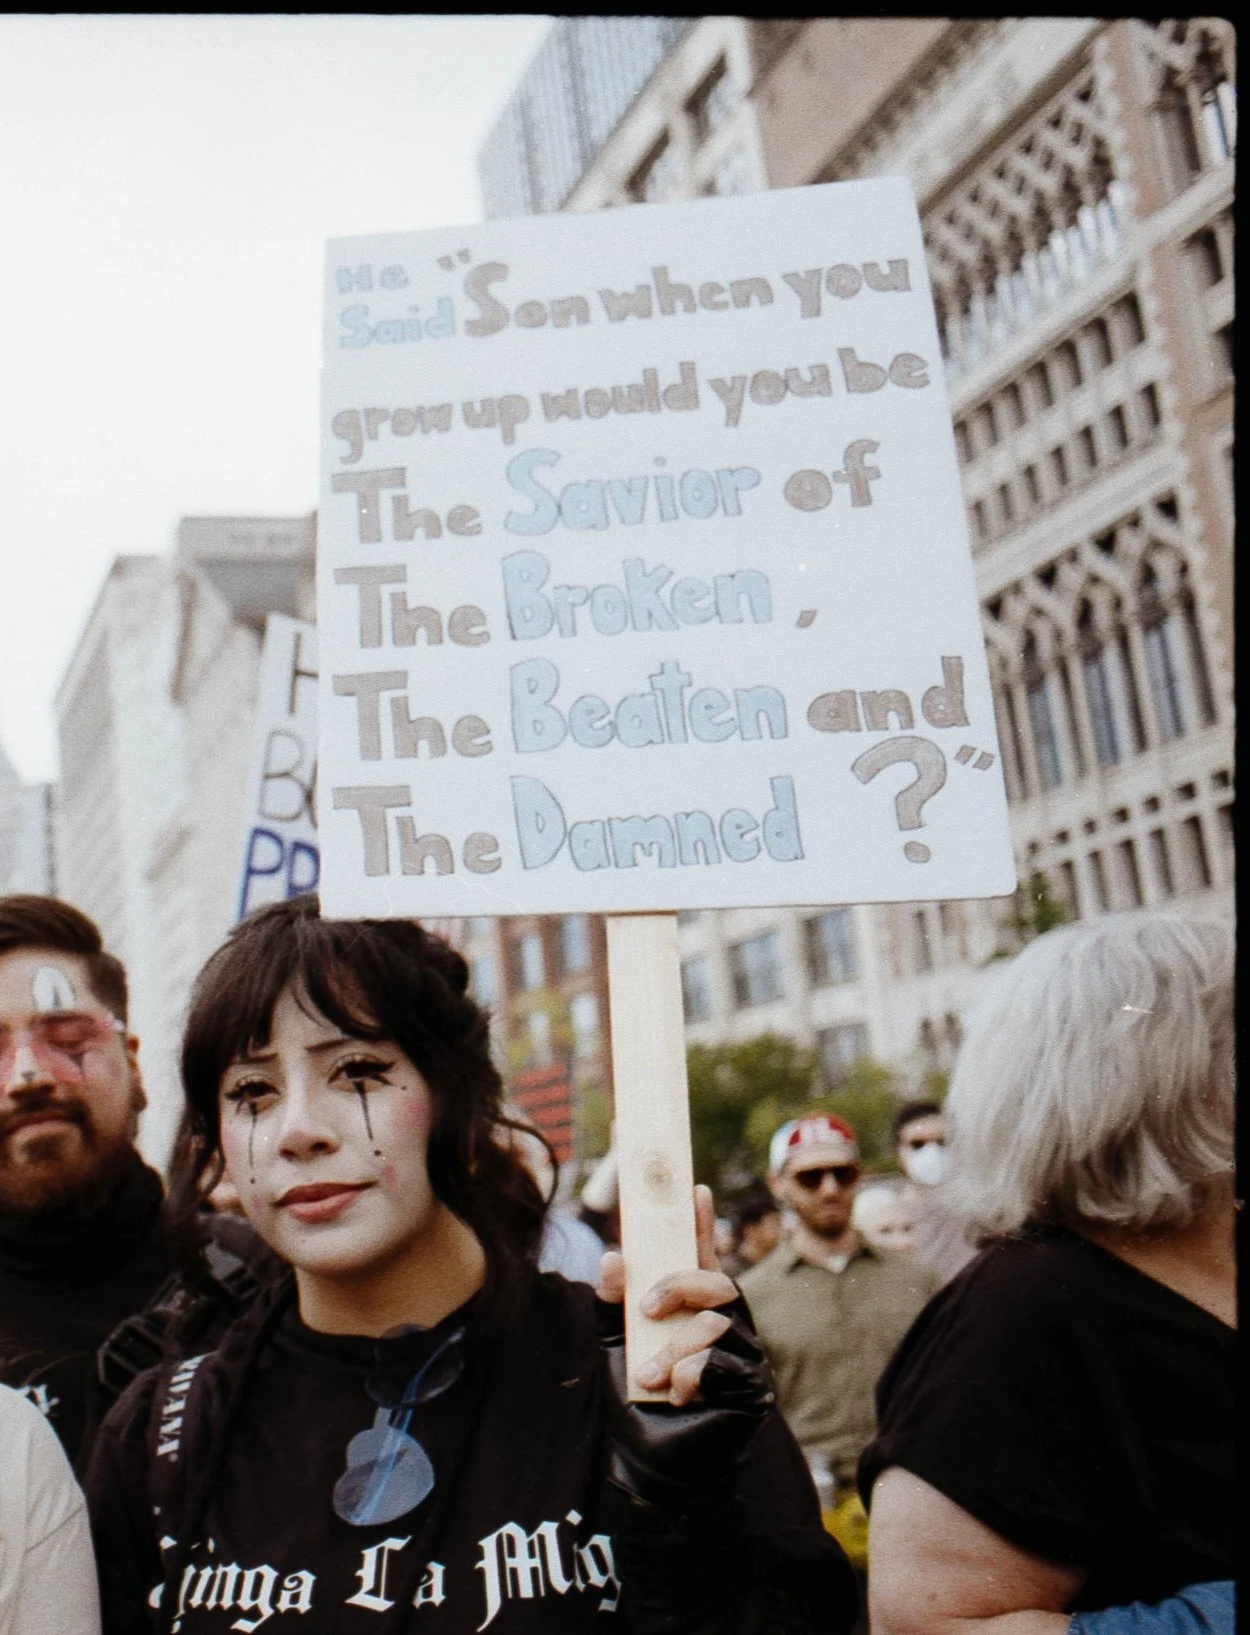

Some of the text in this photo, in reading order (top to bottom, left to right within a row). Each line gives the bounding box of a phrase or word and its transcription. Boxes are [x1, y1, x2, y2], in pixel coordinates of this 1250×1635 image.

[336, 264, 411, 293] He
[598, 265, 775, 323] when
[782, 258, 912, 318] you
[339, 297, 455, 350] Said
[331, 347, 931, 465] grow up would you be
[331, 438, 881, 543] The Savior of
[334, 564, 491, 649] The
[332, 670, 493, 762] The
[509, 657, 789, 754] Beaten
[807, 656, 970, 733] and
[331, 785, 501, 877] The
[509, 774, 805, 872] Damned
[346, 1535, 446, 1612] La
